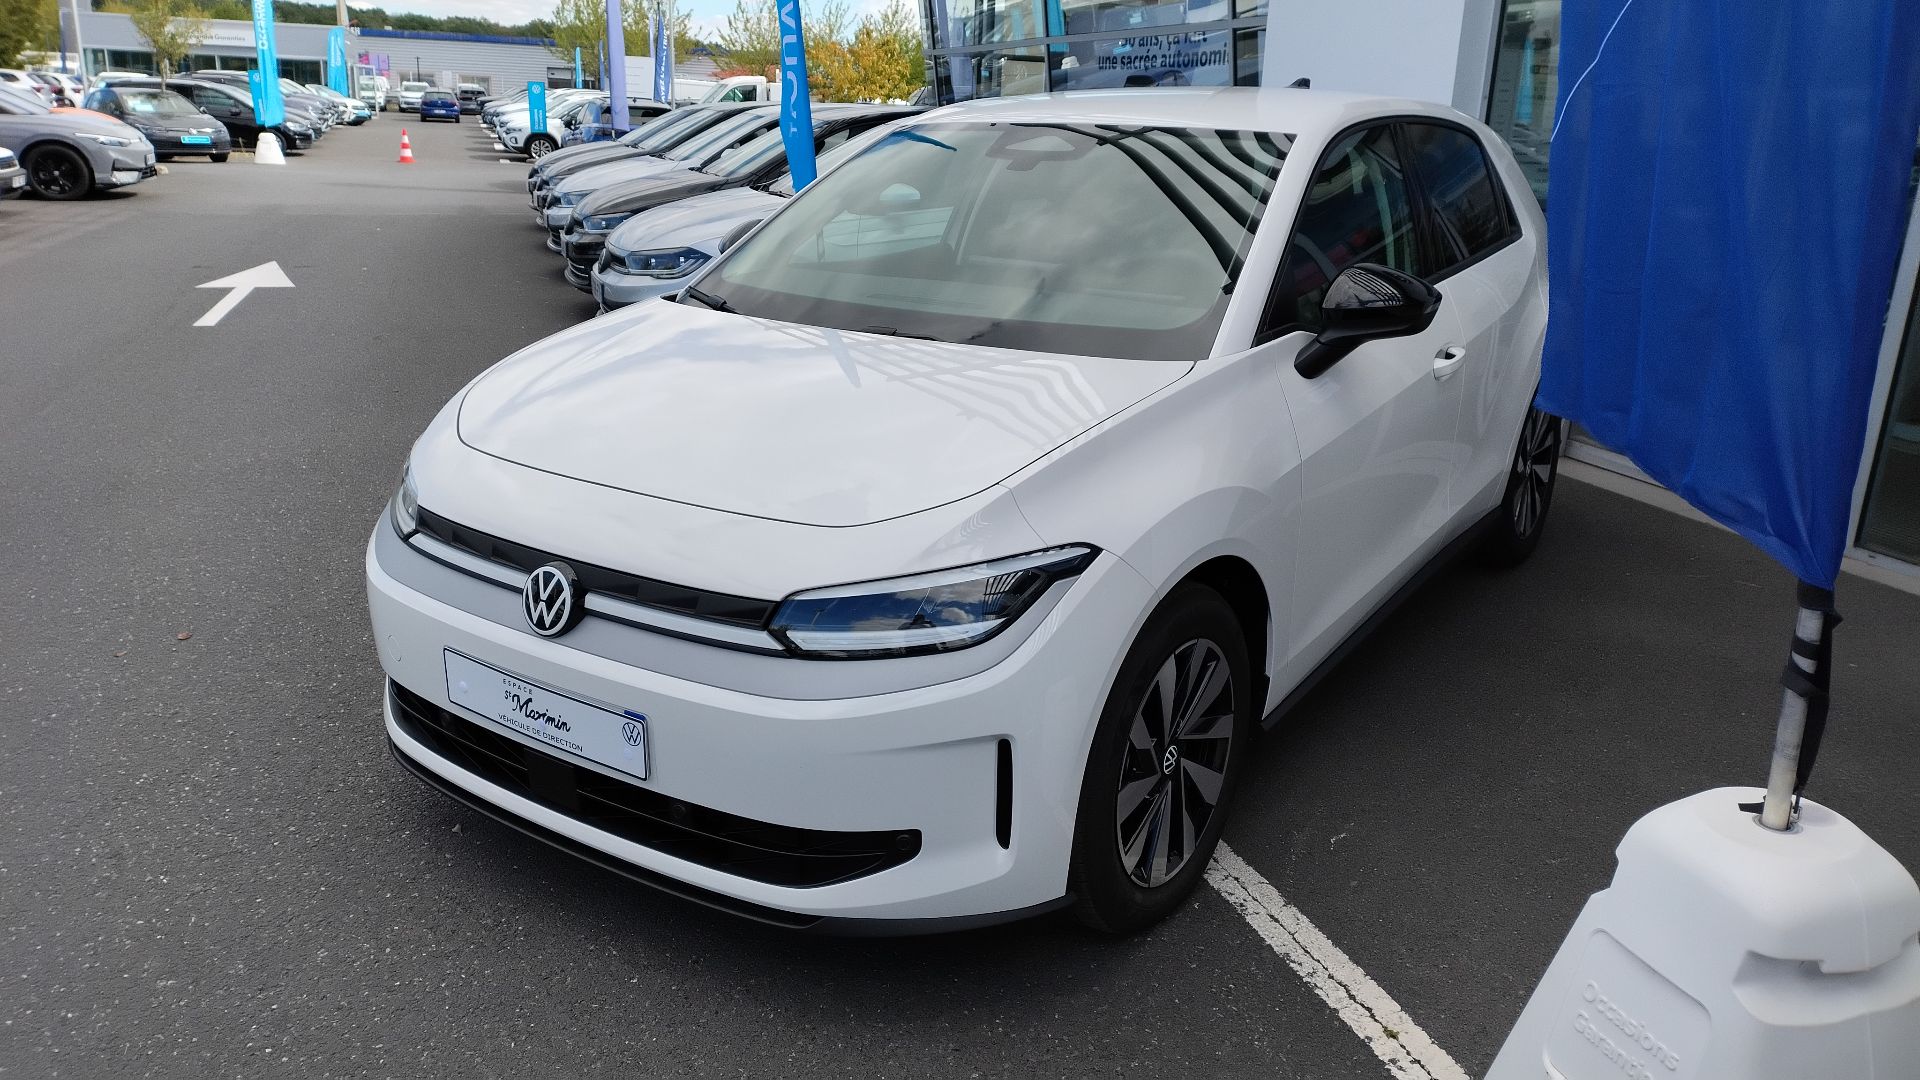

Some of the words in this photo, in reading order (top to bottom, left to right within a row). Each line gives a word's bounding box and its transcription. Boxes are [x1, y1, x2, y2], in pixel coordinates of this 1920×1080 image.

[1098, 55, 1118, 70] une
[1120, 48, 1158, 70] sacrée
[503, 679, 533, 695] ESPACE
[504, 690, 511, 700] St
[512, 694, 571, 732] Maximin
[532, 727, 541, 737] DE
[543, 732, 583, 753] DIRECTION
[1582, 979, 1680, 1072] Occasions
